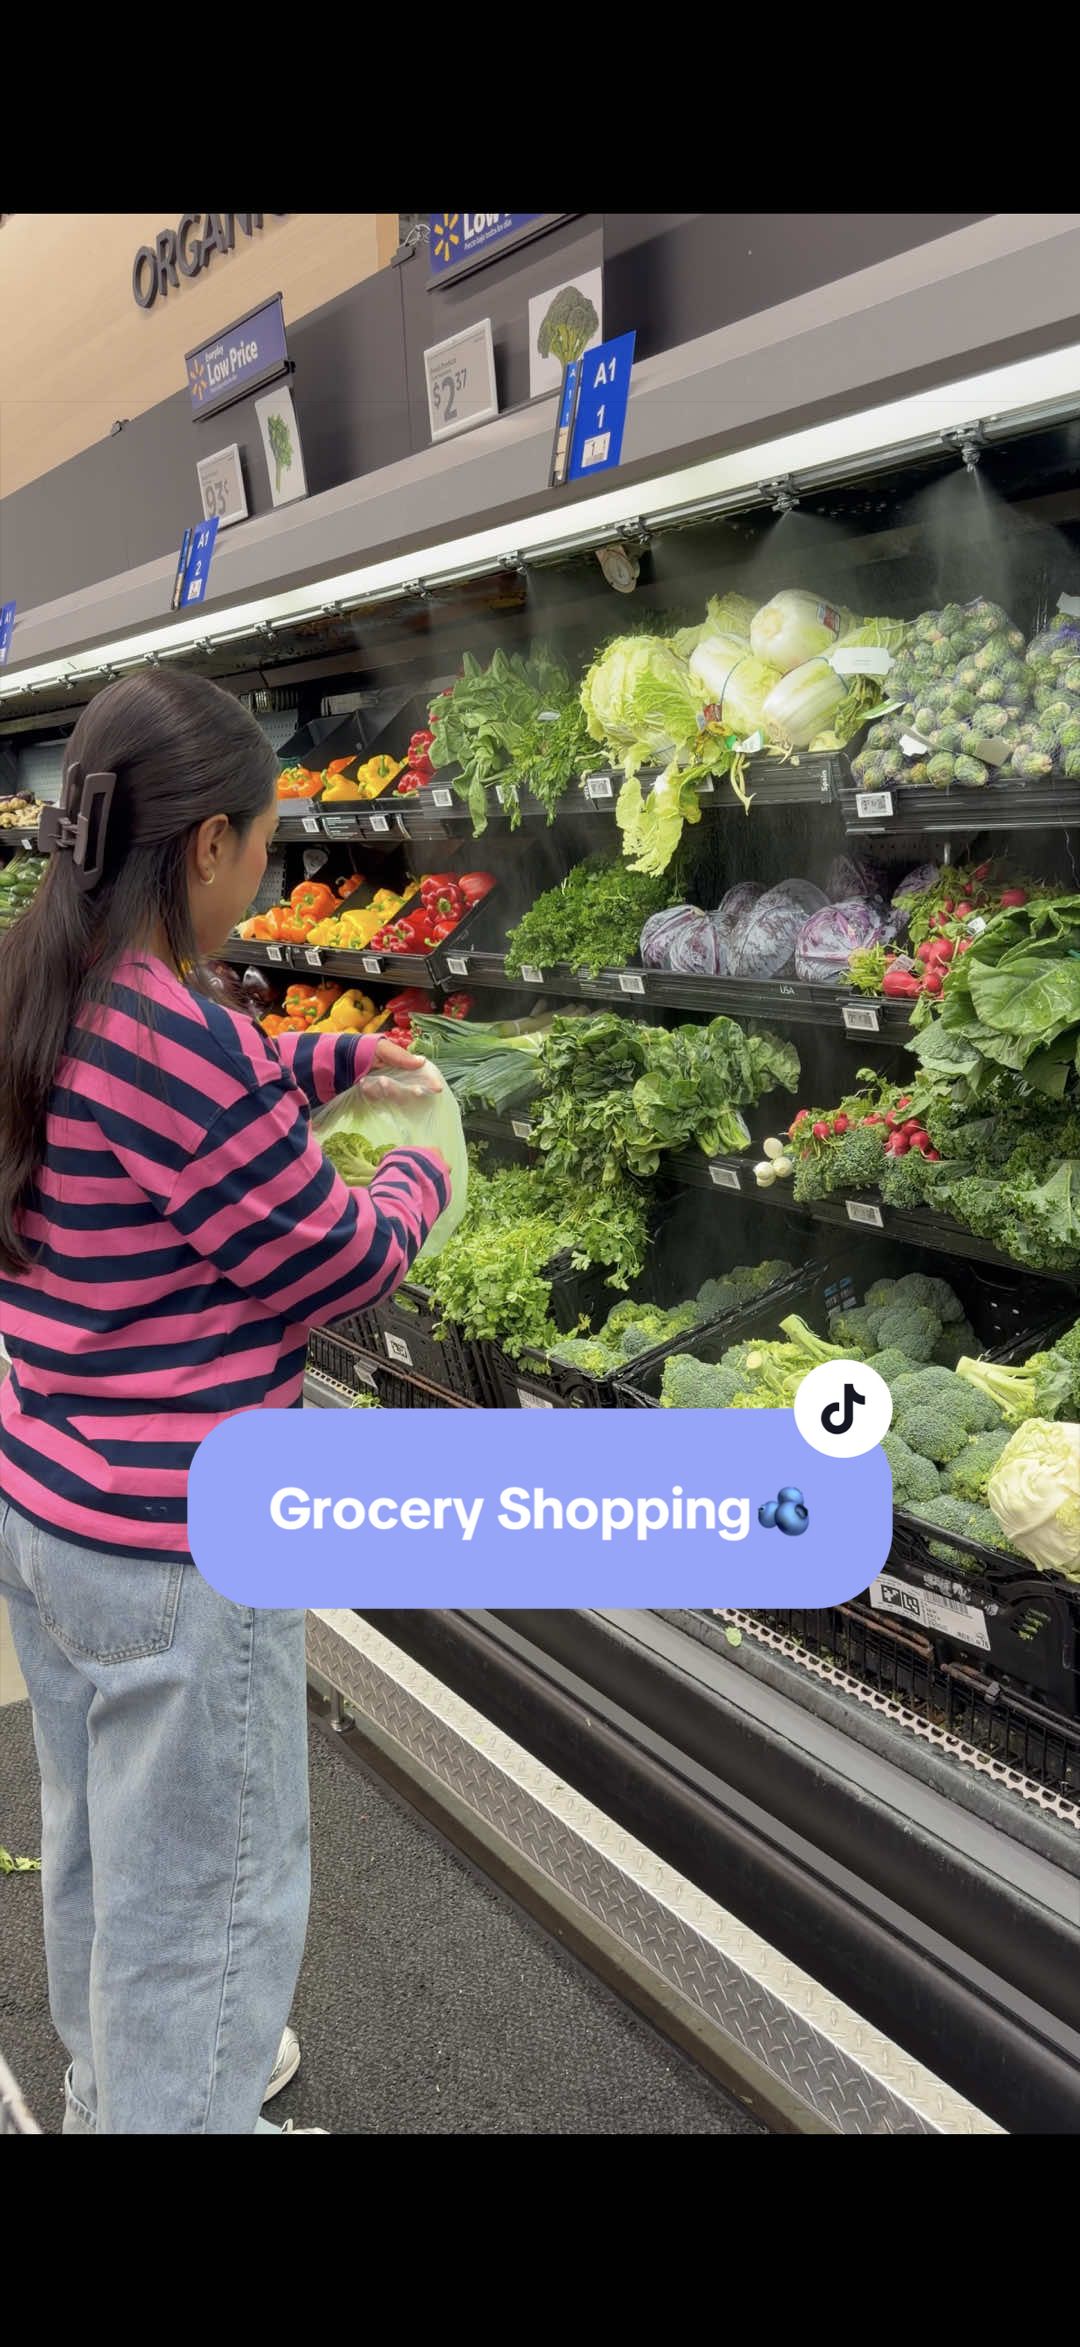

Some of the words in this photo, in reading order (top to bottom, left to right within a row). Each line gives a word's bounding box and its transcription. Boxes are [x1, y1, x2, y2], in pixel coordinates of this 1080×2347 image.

[133, 213, 288, 308] ORGAN
[207, 358, 229, 385] Low
[229, 341, 259, 373] Price
[593, 356, 617, 389] A1
[597, 404, 606, 429] 1
[197, 530, 210, 549] A1
[194, 560, 202, 577] 2
[821, 769, 830, 792] Spain
[780, 984, 796, 995] USA
